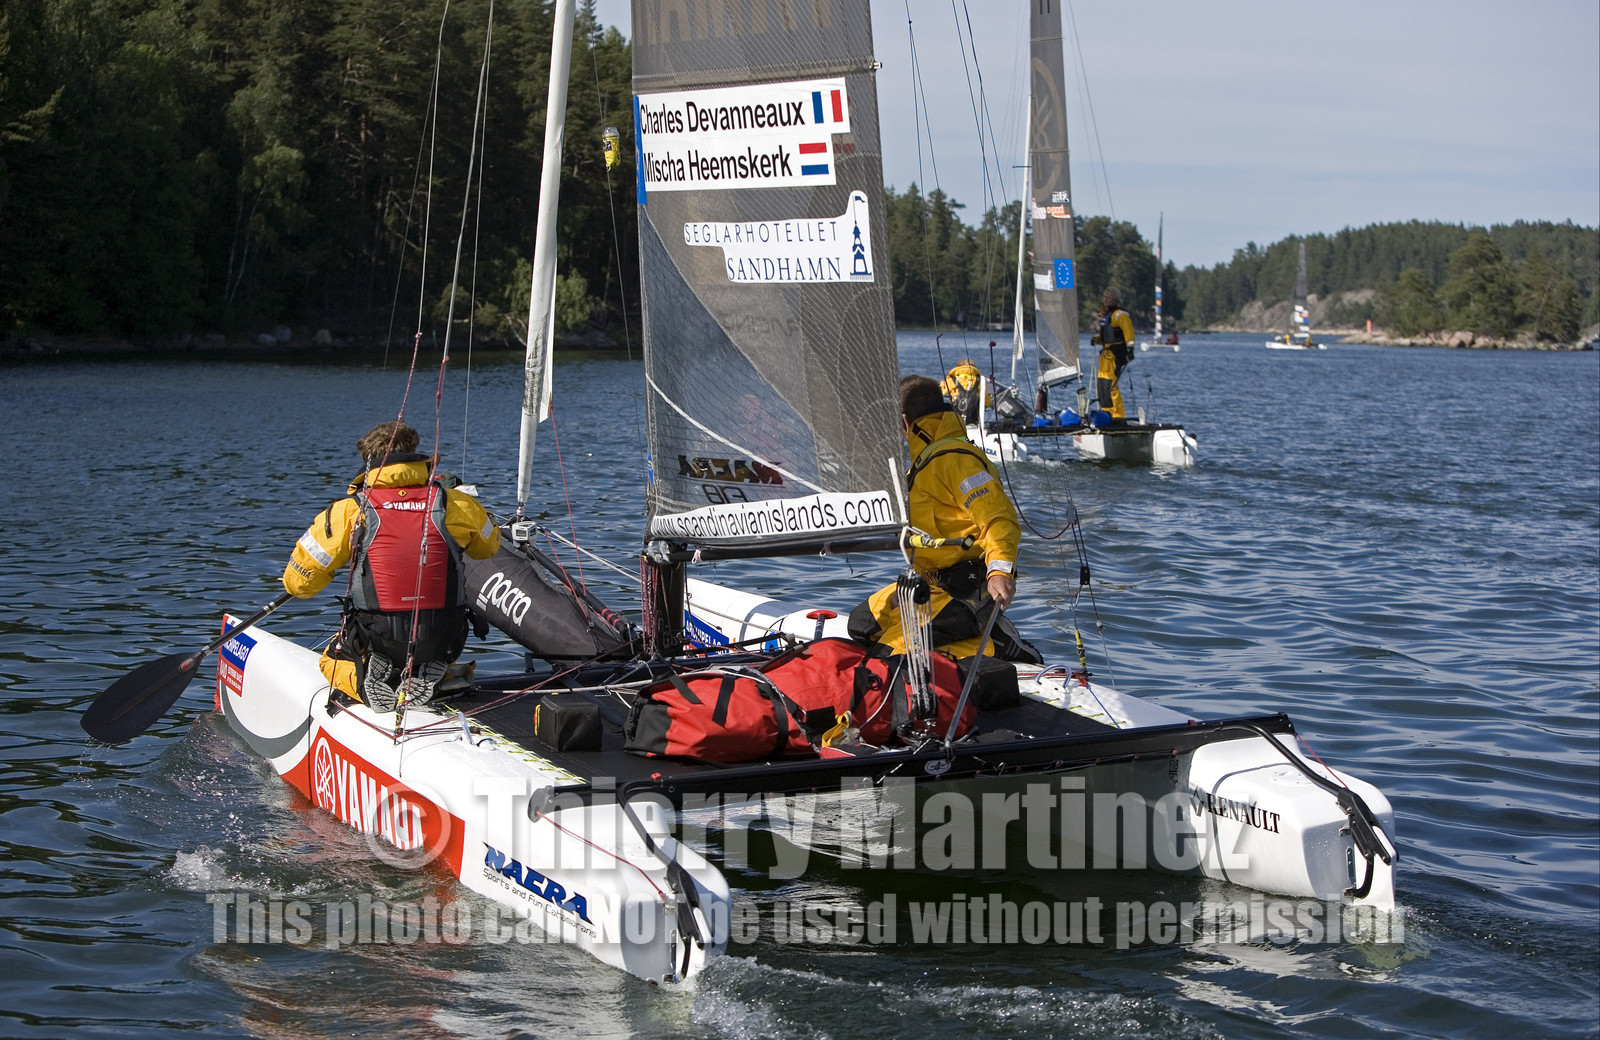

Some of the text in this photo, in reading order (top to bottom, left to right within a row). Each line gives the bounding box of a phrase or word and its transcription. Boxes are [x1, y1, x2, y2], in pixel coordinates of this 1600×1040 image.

[640, 101, 806, 135] Charles Devanneaux
[643, 145, 793, 183] Mischa Heemskerk
[684, 221, 837, 244] SEGLARHOTELLET
[726, 257, 842, 281] SANDHAMN
[1206, 792, 1281, 835] RENAULT
[482, 841, 595, 926] NAERA
[482, 867, 598, 939] Sports and Fun Catamarans
